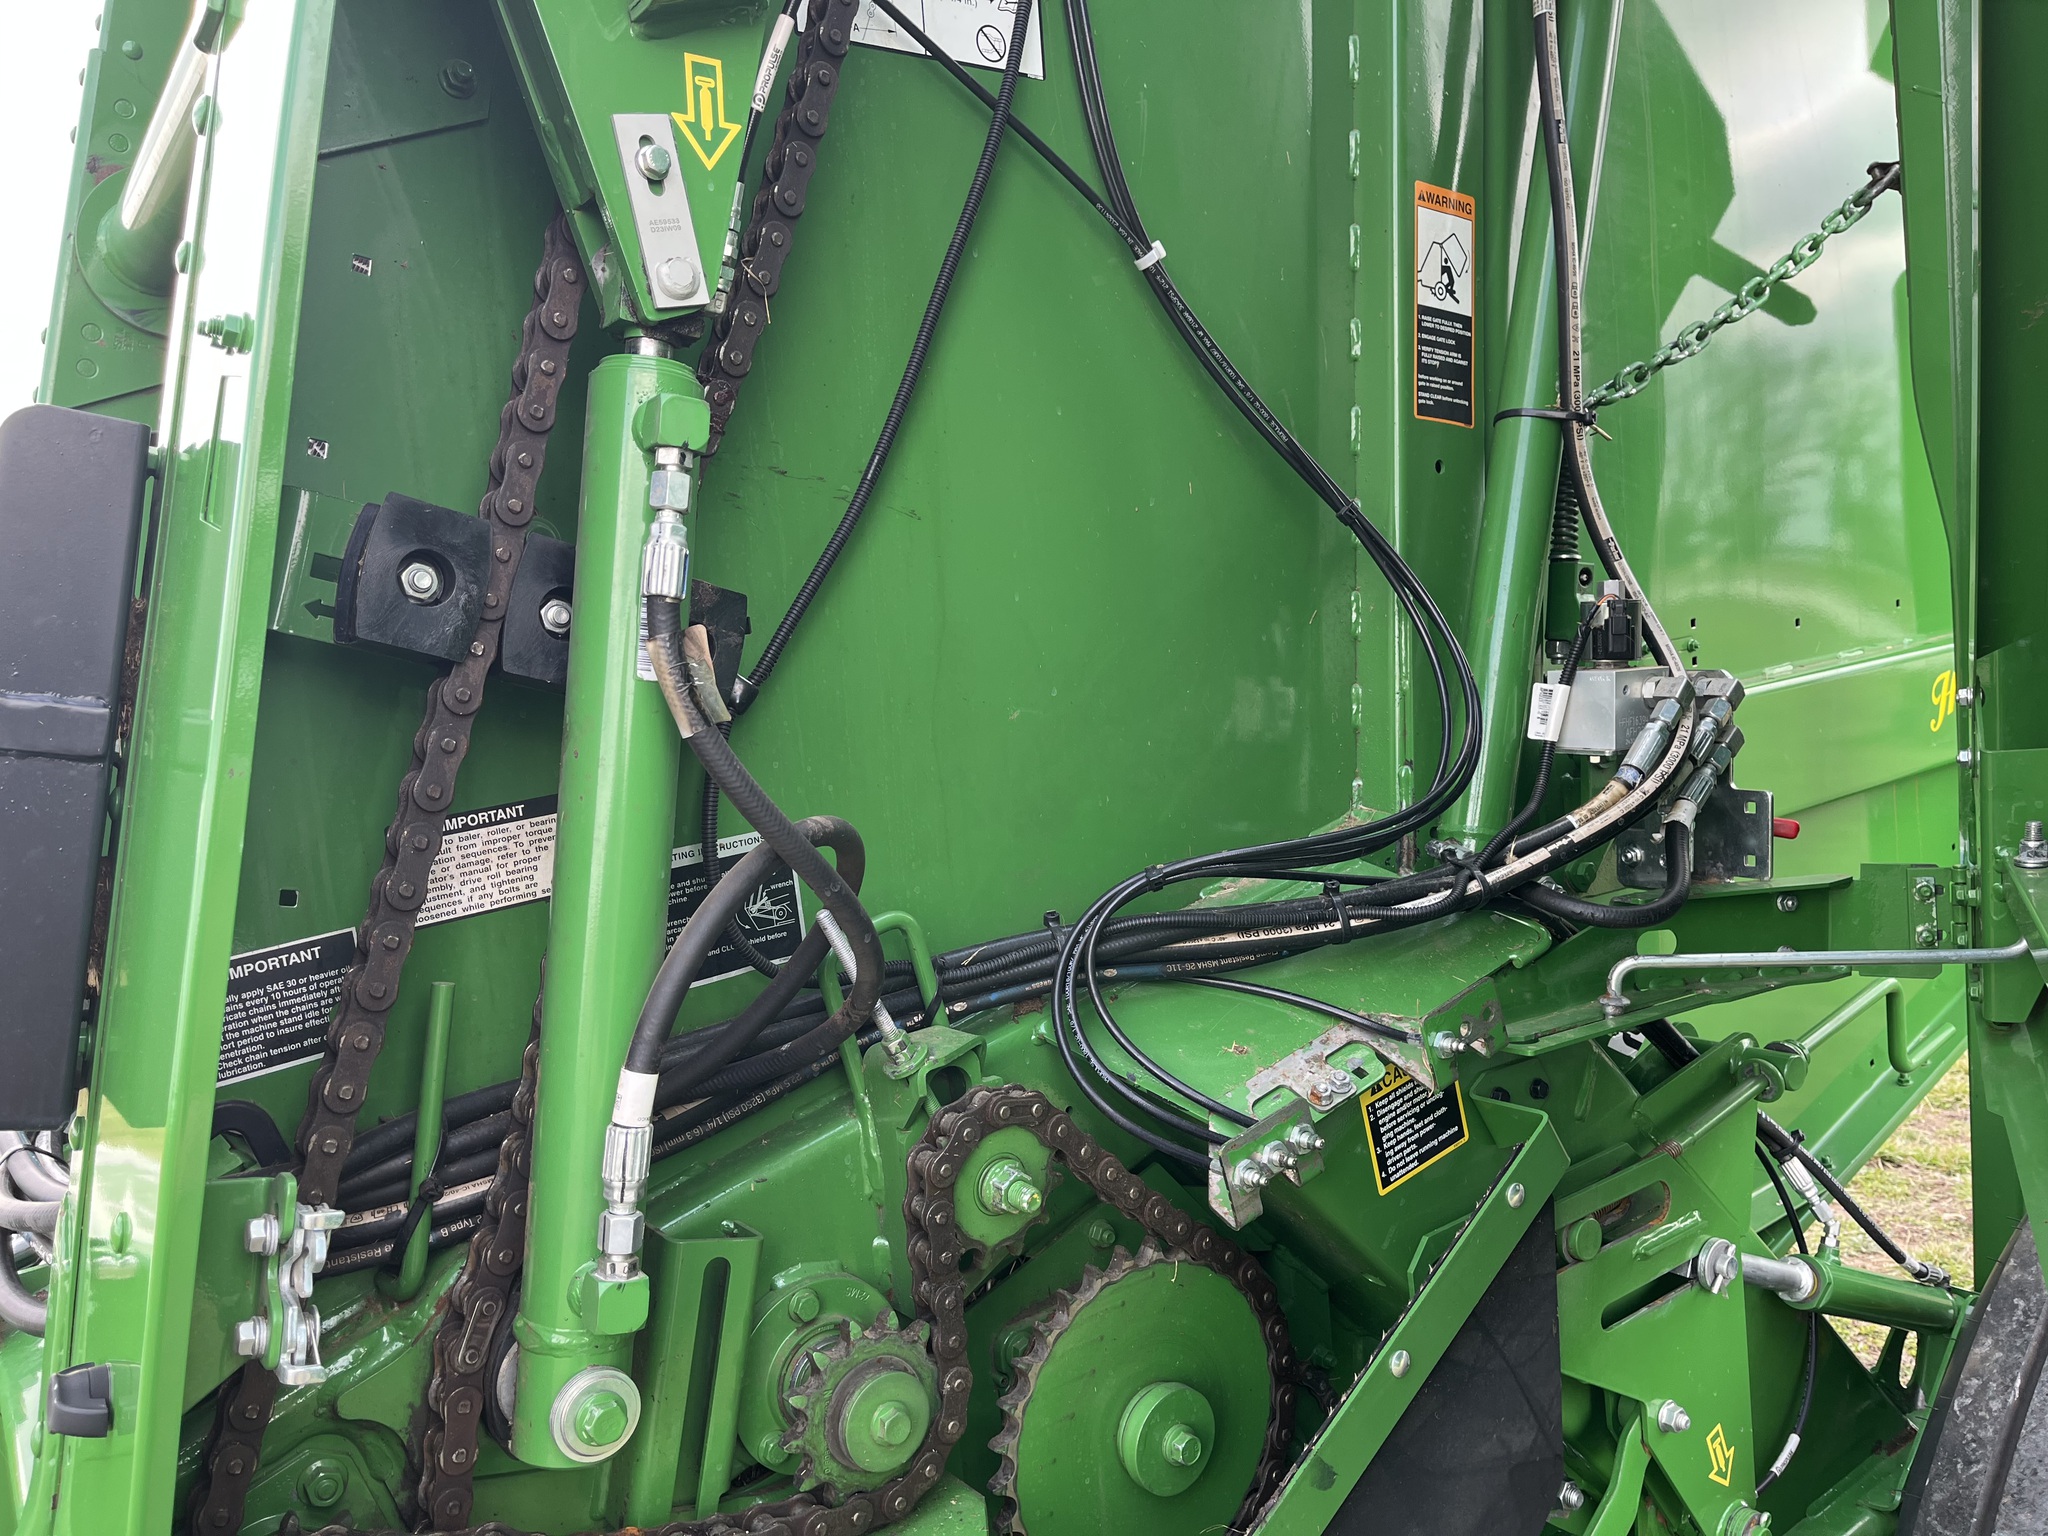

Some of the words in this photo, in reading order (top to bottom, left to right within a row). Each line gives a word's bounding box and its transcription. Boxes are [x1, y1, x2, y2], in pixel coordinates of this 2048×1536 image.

[853, 23, 860, 33] A
[759, 44, 780, 93] PROPULSE
[1426, 191, 1472, 215] WARNING
[1119, 227, 1127, 237] USA
[1203, 337, 1211, 347] MAX
[1572, 351, 1580, 360] 21
[1236, 380, 1245, 389] SAE
[1572, 366, 1581, 386] MPa
[1573, 391, 1581, 412] (300
[1271, 420, 1288, 442] PROPULSE
[1680, 725, 1690, 733] 21
[1674, 736, 1688, 749] MPa
[1663, 751, 1680, 770] (3000
[456, 842, 477, 853] from
[482, 834, 521, 847] improper
[525, 827, 553, 837] torque
[458, 833, 483, 843] baler,
[487, 826, 512, 837] roller,
[530, 817, 556, 828] bearin
[455, 857, 493, 871] damage,
[497, 851, 517, 860] refer
[522, 848, 531, 856] to
[535, 845, 549, 854] the
[461, 845, 510, 860] sequences.
[514, 841, 524, 849] To
[671, 850, 695, 861] TING
[718, 835, 764, 851] RUCTIONS
[460, 865, 492, 878] manual
[496, 862, 508, 870] for
[513, 855, 541, 867] proper
[460, 877, 482, 888] drive
[487, 872, 501, 880] roll
[506, 864, 538, 877] bearing
[470, 885, 486, 894] and
[491, 874, 534, 889] tightening
[478, 891, 494, 901] any
[498, 885, 520, 896] bolts
[525, 882, 539, 890] are
[685, 884, 708, 895] before
[770, 880, 793, 890] wrench
[462, 902, 485, 913] while
[490, 891, 537, 908] performing
[768, 931, 787, 940] before
[1237, 927, 1260, 941] PSI)
[228, 946, 322, 981] MPORTANT
[1199, 958, 1219, 970] MSHA
[241, 987, 264, 999] apply
[266, 982, 285, 992] SAE
[286, 978, 296, 988] 30
[309, 968, 339, 982] heavier
[246, 996, 268, 1008] every
[271, 992, 281, 1000] 10
[282, 986, 307, 997] hours
[309, 982, 317, 991] of
[248, 1003, 277, 1016] chains
[278, 990, 328, 1007] immediately
[251, 1013, 274, 1024] when
[275, 1008, 289, 1017] the
[291, 1001, 318, 1013] chains
[321, 998, 333, 1006] are
[225, 1031, 240, 1040] the
[241, 1022, 277, 1036] machine
[279, 1014, 302, 1026] stand
[305, 1010, 319, 1020] idle
[237, 1034, 264, 1049] period
[266, 1031, 275, 1039] to
[277, 1024, 303, 1036] insure
[218, 1057, 243, 1071] Check
[245, 1050, 268, 1063] chain
[270, 1042, 301, 1055] tension
[303, 1036, 321, 1046] after
[219, 1061, 266, 1080] lubrication.
[765, 1082, 784, 1096] MPa
[1375, 1097, 1388, 1109] Keep
[1388, 1093, 1396, 1103] all
[1396, 1082, 1414, 1097] shields
[742, 1093, 766, 1113] (3250
[1377, 1098, 1403, 1117] Disengage
[1404, 1092, 1413, 1101] and
[1379, 1112, 1396, 1125] engine
[1396, 1101, 1412, 1114] and/or
[1413, 1091, 1427, 1104] motor
[1380, 1119, 1396, 1133] before
[1397, 1105, 1420, 1122] servicing
[1420, 1101, 1426, 1109] or
[1382, 1130, 1394, 1143] ging
[1383, 1137, 1396, 1150] Keep
[1414, 1121, 1424, 1131] feet
[1424, 1115, 1434, 1128] and
[1385, 1146, 1394, 1157] ing
[1395, 1142, 1407, 1152] away
[1408, 1132, 1420, 1143] from
[1388, 1165, 1396, 1174] Do
[1396, 1159, 1405, 1169] not
[1405, 1151, 1418, 1163] leave
[1419, 1138, 1438, 1155] running
[1438, 1125, 1459, 1142] machine
[1387, 1152, 1404, 1166] driven
[440, 1228, 449, 1237] B
[451, 1217, 475, 1233] Type
[327, 1247, 382, 1268] Resistant
